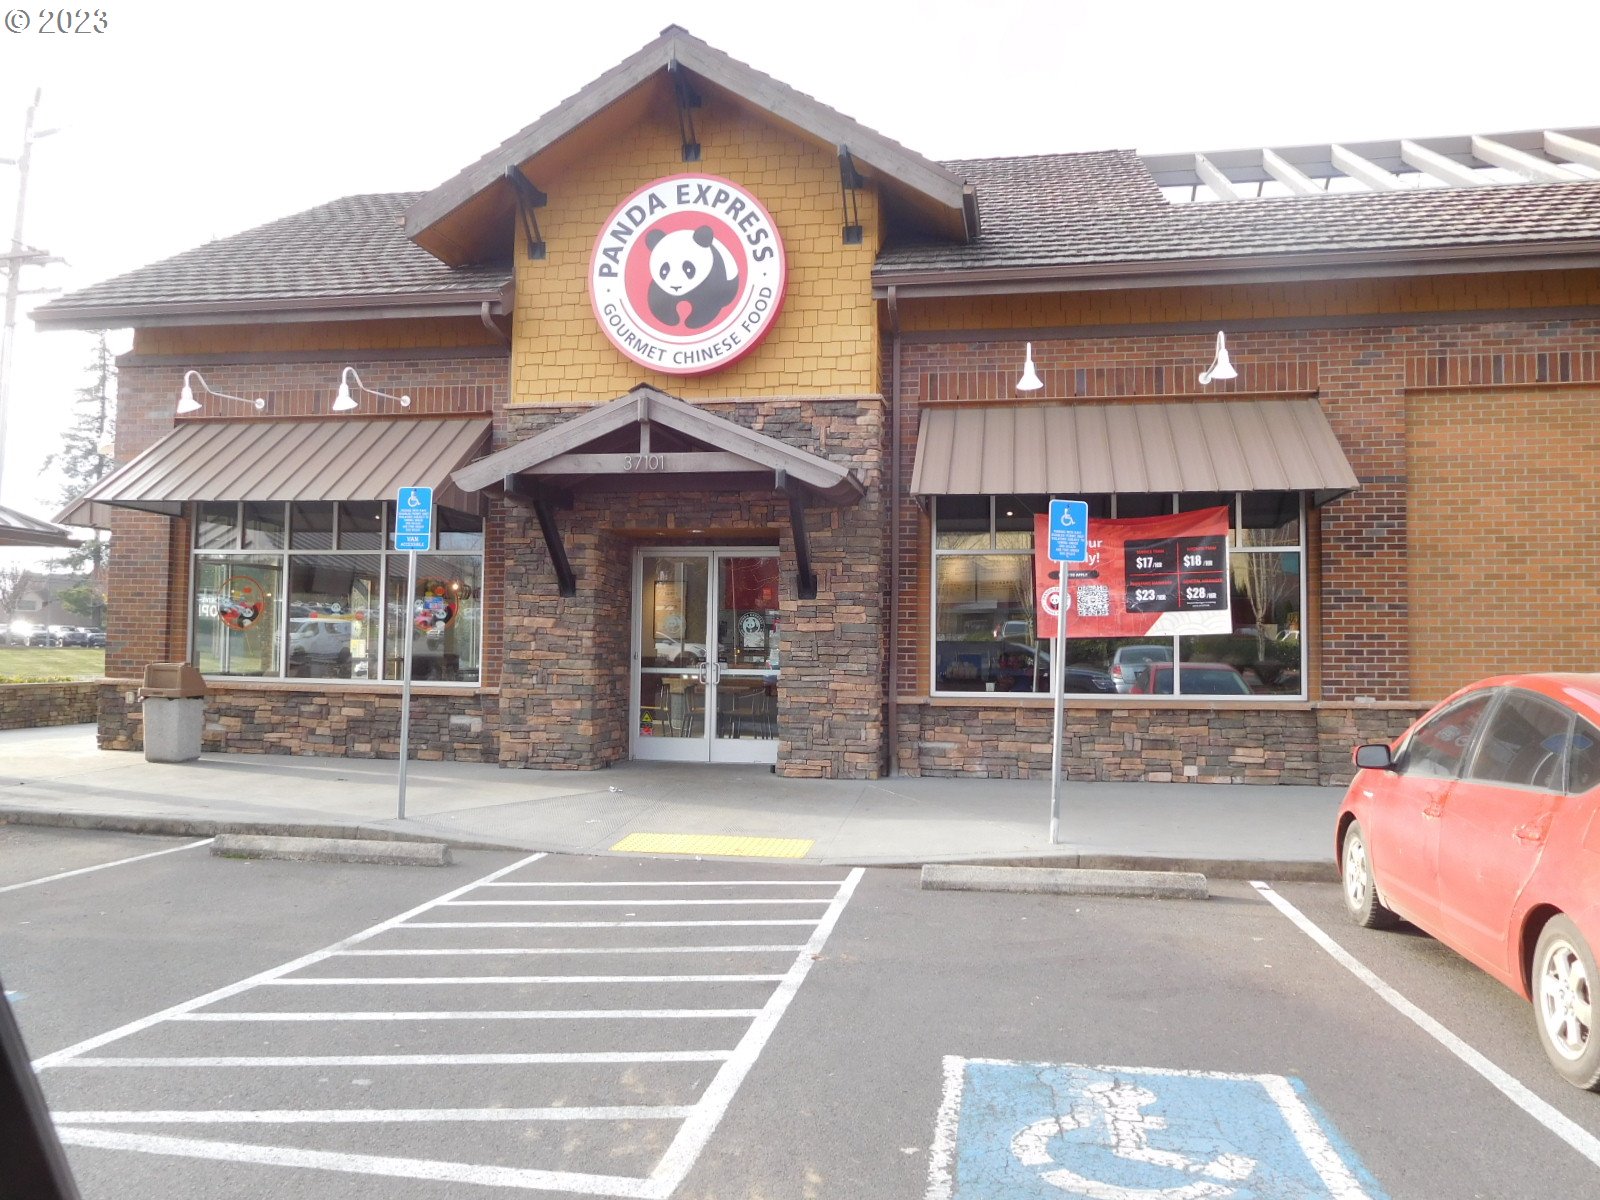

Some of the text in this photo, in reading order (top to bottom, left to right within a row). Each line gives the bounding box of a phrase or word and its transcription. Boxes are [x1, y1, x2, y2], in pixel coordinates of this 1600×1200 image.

[598, 183, 774, 278] PANDA EXPRESS
[603, 286, 773, 365] GOURMET CHINESE FOOD
[623, 455, 664, 471] 37101
[1183, 554, 1202, 568] $18
[1135, 588, 1155, 602] $23
[1186, 586, 1206, 600] $28
